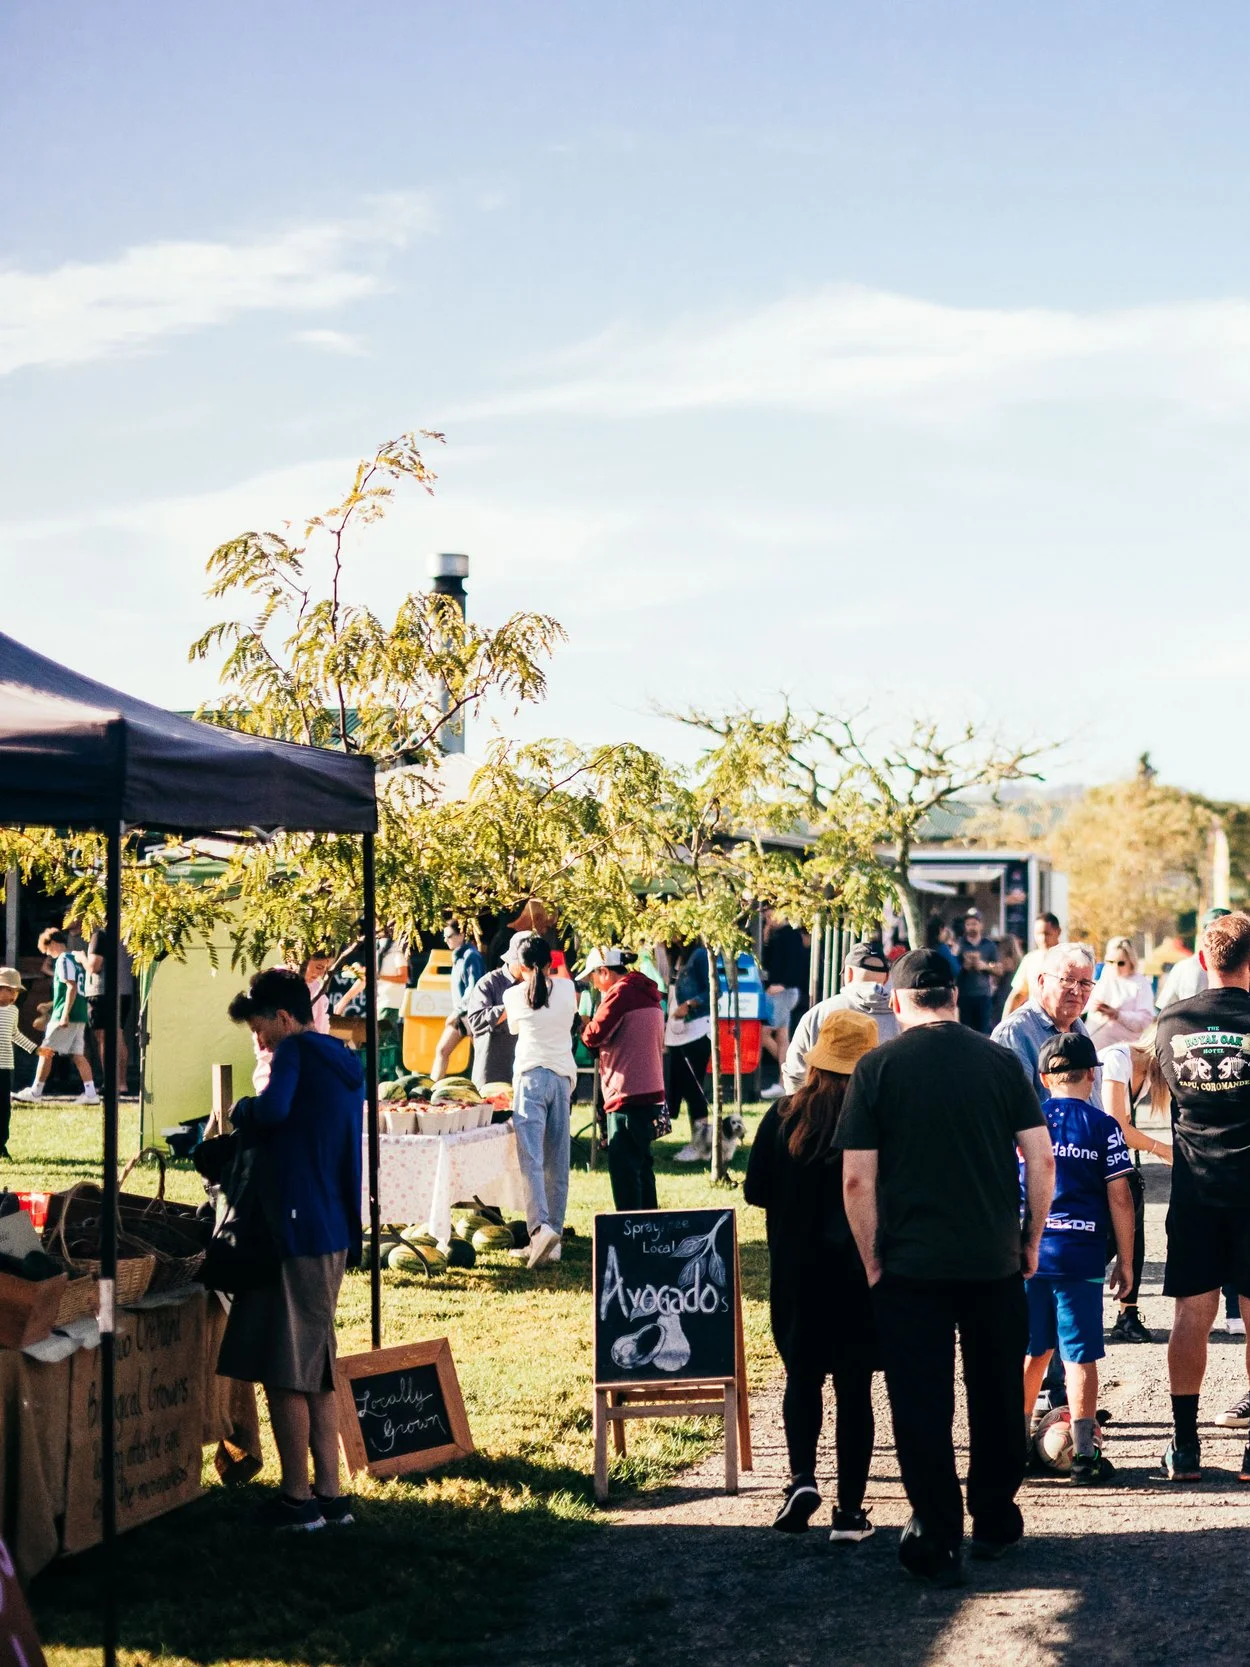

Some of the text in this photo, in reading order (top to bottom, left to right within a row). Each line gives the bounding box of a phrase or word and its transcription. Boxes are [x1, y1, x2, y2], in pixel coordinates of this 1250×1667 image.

[1185, 1035, 1243, 1048] ROYAL OAK
[1179, 1081, 1200, 1090] TAPU,
[1107, 1127, 1126, 1150] sk
[1052, 1142, 1099, 1160] dafone
[1106, 1150, 1130, 1167] SPO
[623, 1220, 661, 1242] Spray
[643, 1240, 675, 1254] Local
[600, 1244, 729, 1321] Avocados
[356, 1376, 433, 1418] Locally
[370, 1414, 446, 1453] Grown
